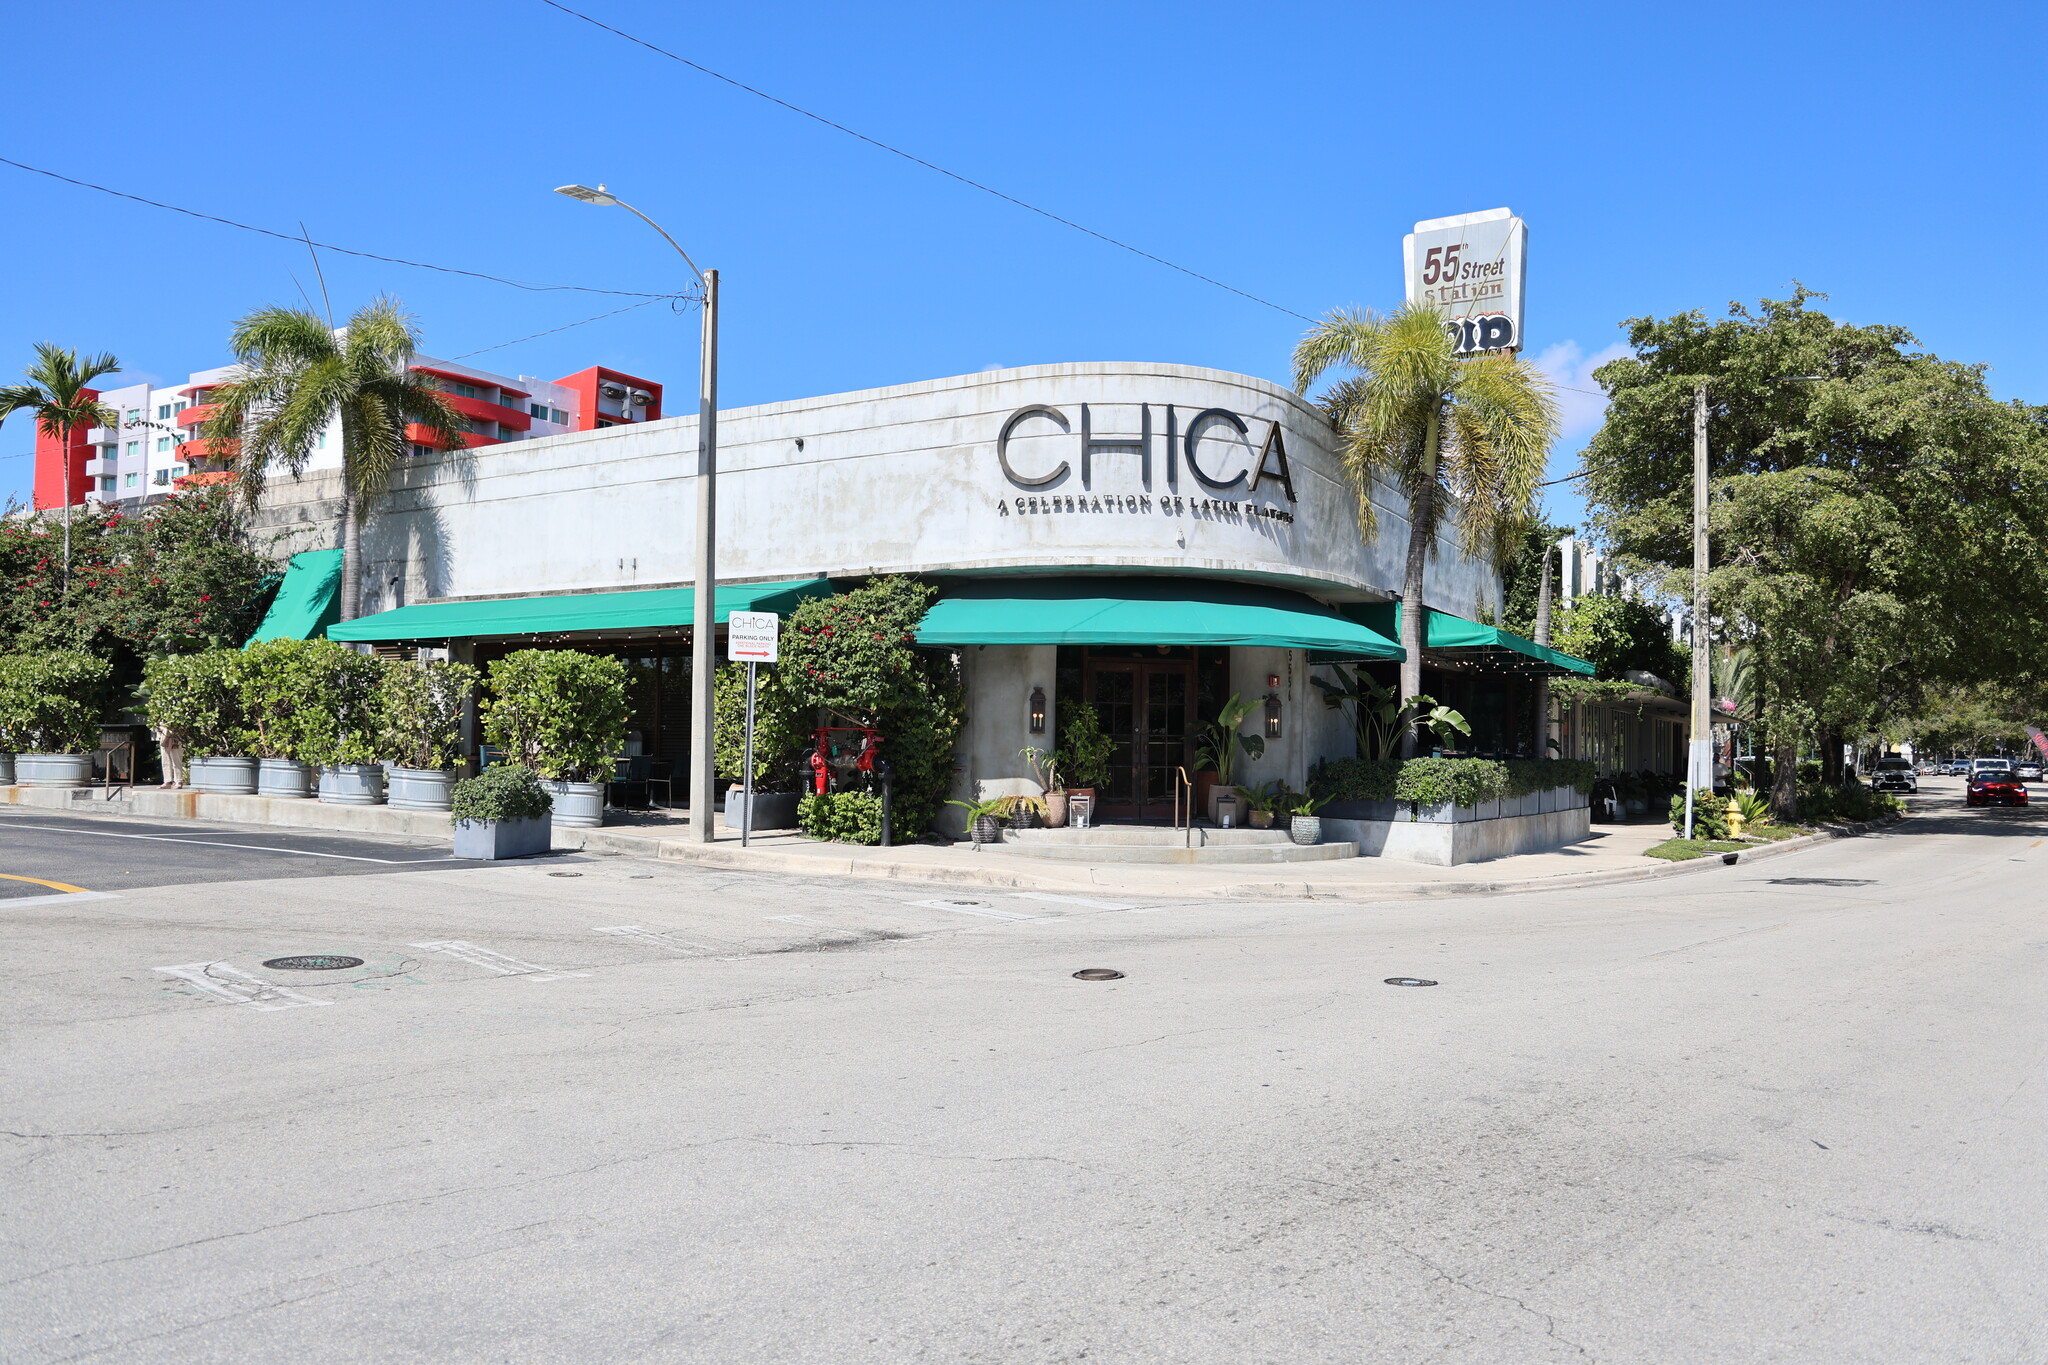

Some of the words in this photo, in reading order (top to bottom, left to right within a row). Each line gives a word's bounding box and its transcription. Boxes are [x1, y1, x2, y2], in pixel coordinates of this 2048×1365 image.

[1461, 257, 1505, 280] Street
[997, 402, 1297, 502] CHICA
[1015, 494, 1151, 511] CELEBRATION
[1160, 496, 1182, 508] OF
[1190, 497, 1239, 512] LATIN
